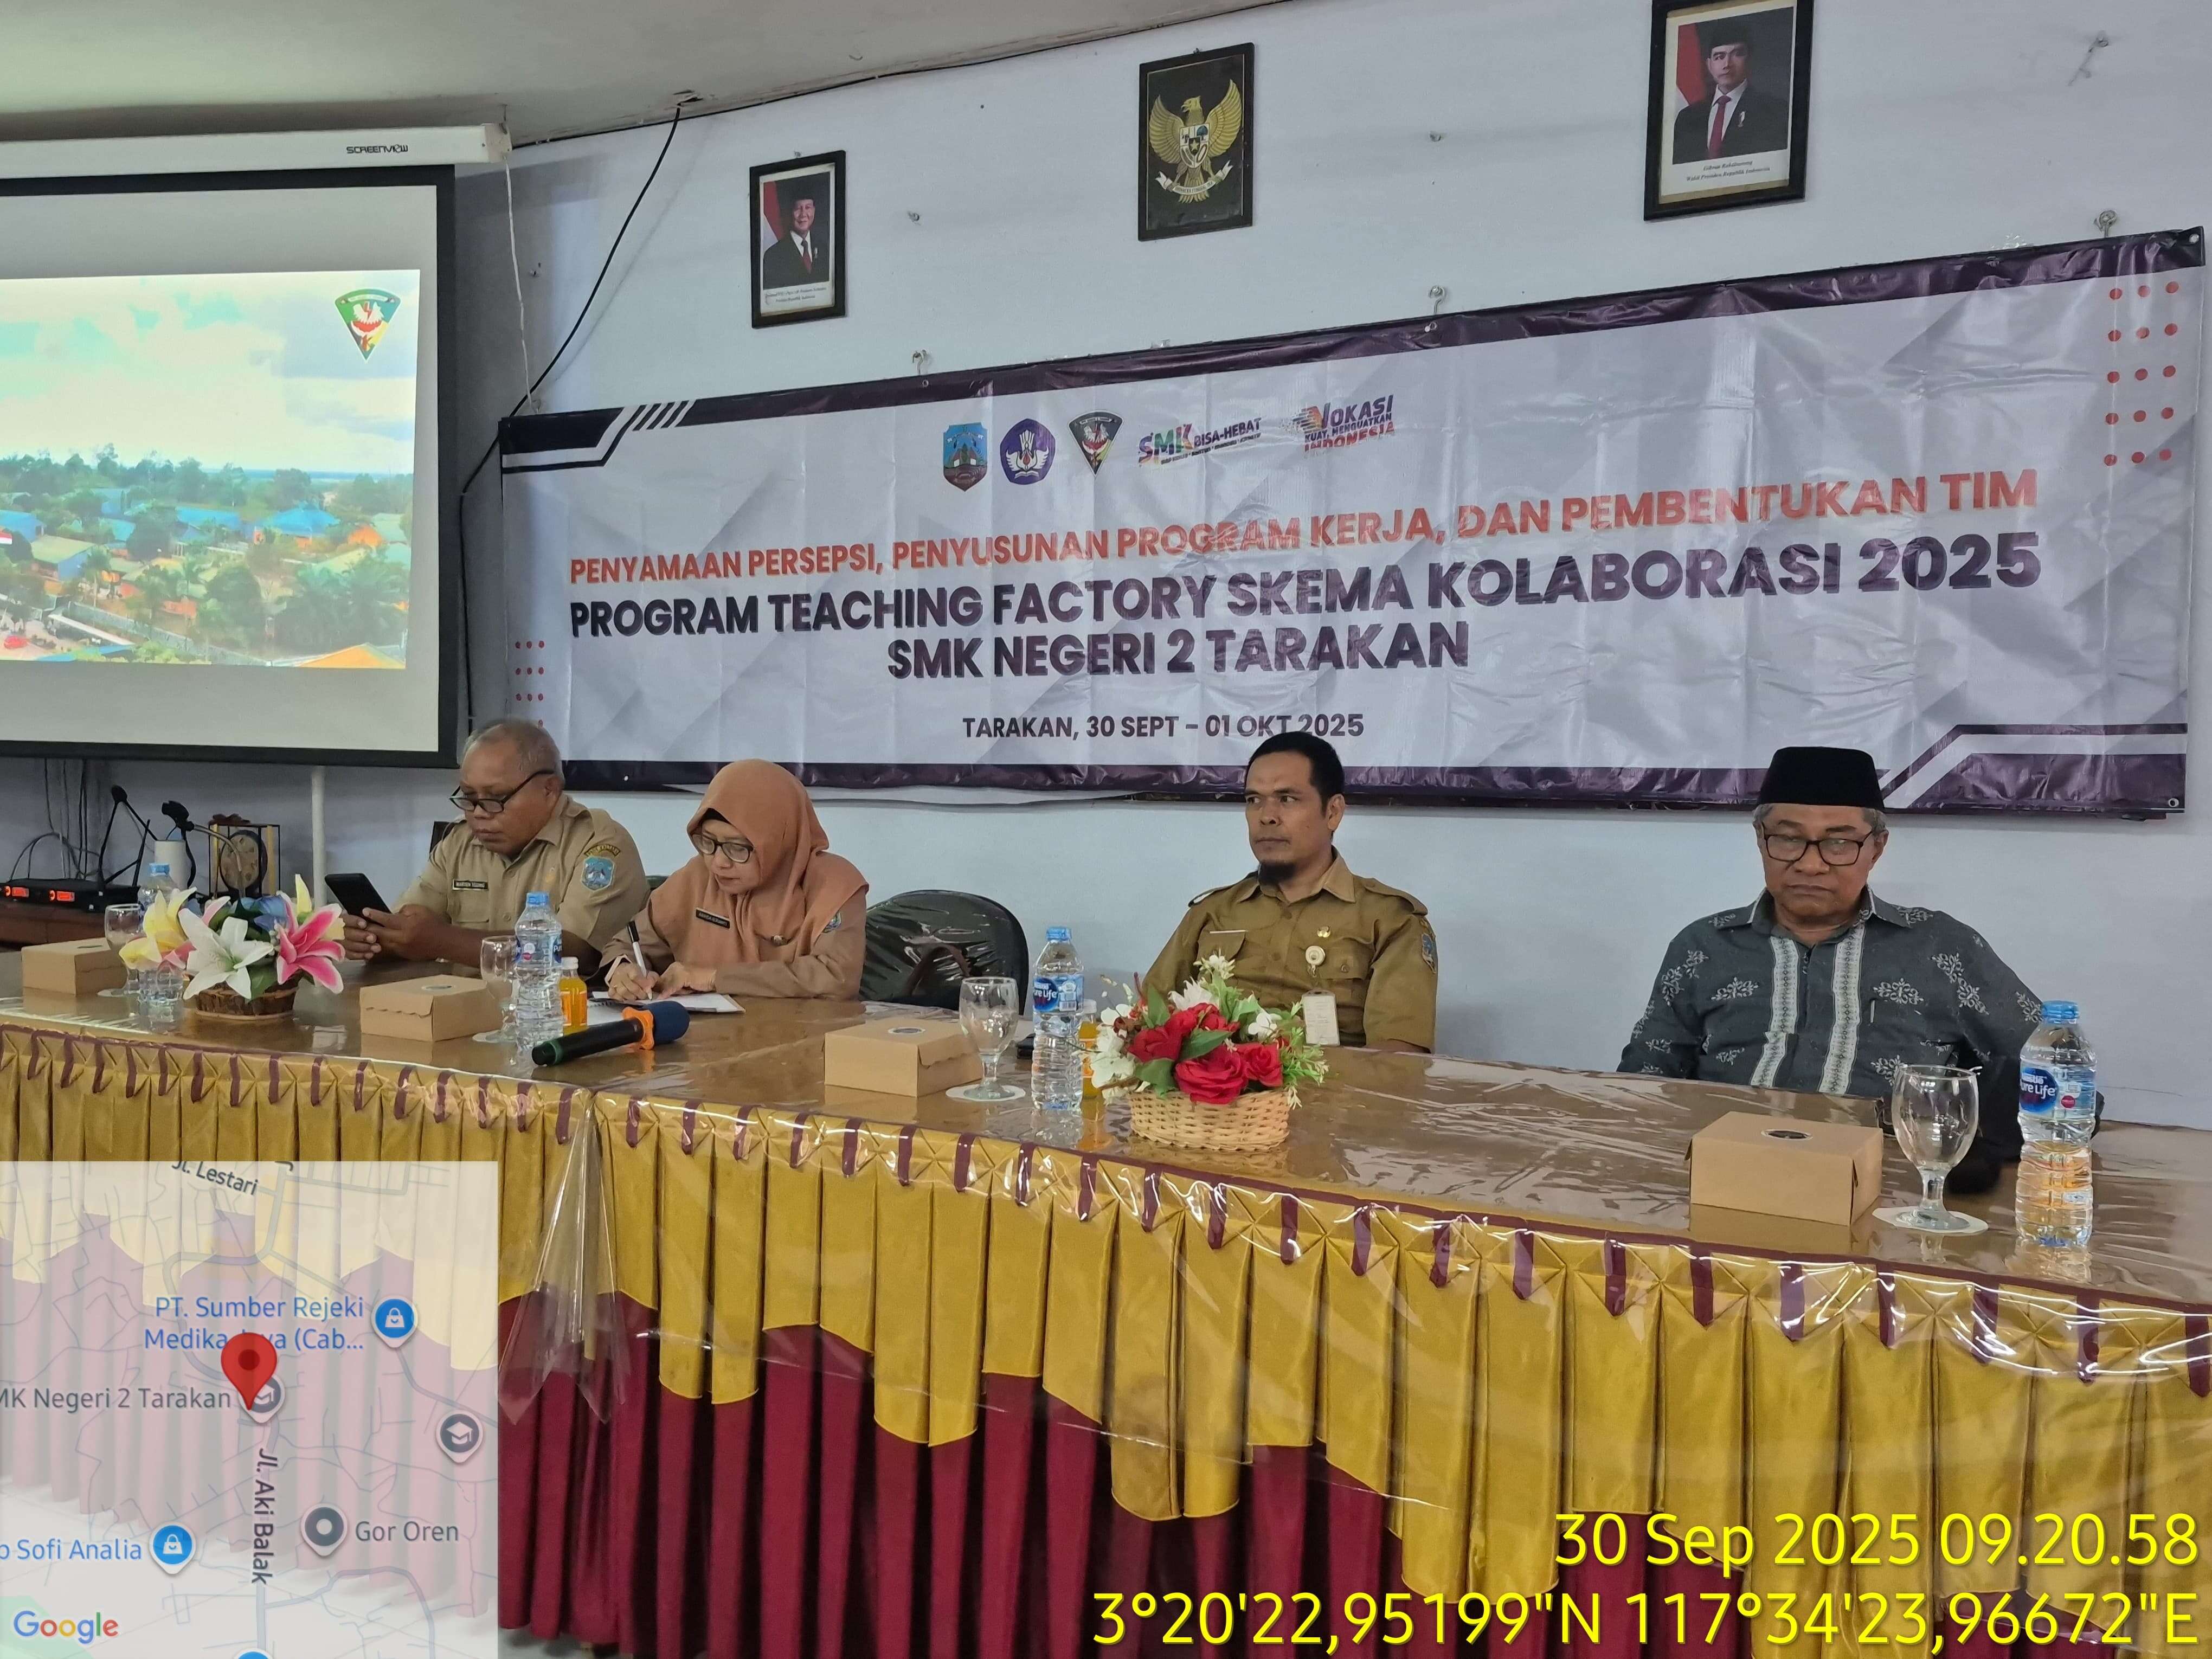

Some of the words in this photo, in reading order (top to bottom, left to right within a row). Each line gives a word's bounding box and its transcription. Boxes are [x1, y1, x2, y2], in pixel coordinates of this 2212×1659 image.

[346, 144, 408, 154] SCREENVIEW
[1139, 423, 1193, 465] SMK
[1194, 417, 1262, 447] BISA-HEBAT
[1304, 421, 1395, 452] INDONESIA
[570, 551, 742, 584] PENYAMAAN
[748, 543, 884, 577] PERSEPSI,
[892, 530, 1109, 569] PENYUSUNAN
[1117, 521, 1300, 558] PROGRAM
[1310, 507, 1444, 545] KERJA,
[1458, 500, 1550, 538] DAN
[1562, 477, 1928, 531] PEMBENTUKAN
[1940, 470, 2038, 511] TIM
[570, 595, 758, 638] PROGRAM
[768, 586, 983, 632] TEACHING
[993, 575, 1217, 626] FACTORY
[1227, 564, 1414, 616] SKEMA
[1427, 542, 1841, 609] KOLABORASI
[1858, 532, 2039, 592] 2025
[888, 637, 983, 679] SMK
[993, 632, 1155, 677] NEGERI
[1167, 628, 1195, 673] 2
[1205, 621, 1469, 673] TARAKAN
[962, 717, 1079, 741] TARAKAN,
[1086, 716, 1115, 738] 30
[1121, 716, 1179, 737] SEPT
[1205, 715, 1230, 737] 01
[1237, 715, 1292, 737] OKT
[1297, 713, 1365, 737] 2025
[2035, 1084, 2056, 1099] Life
